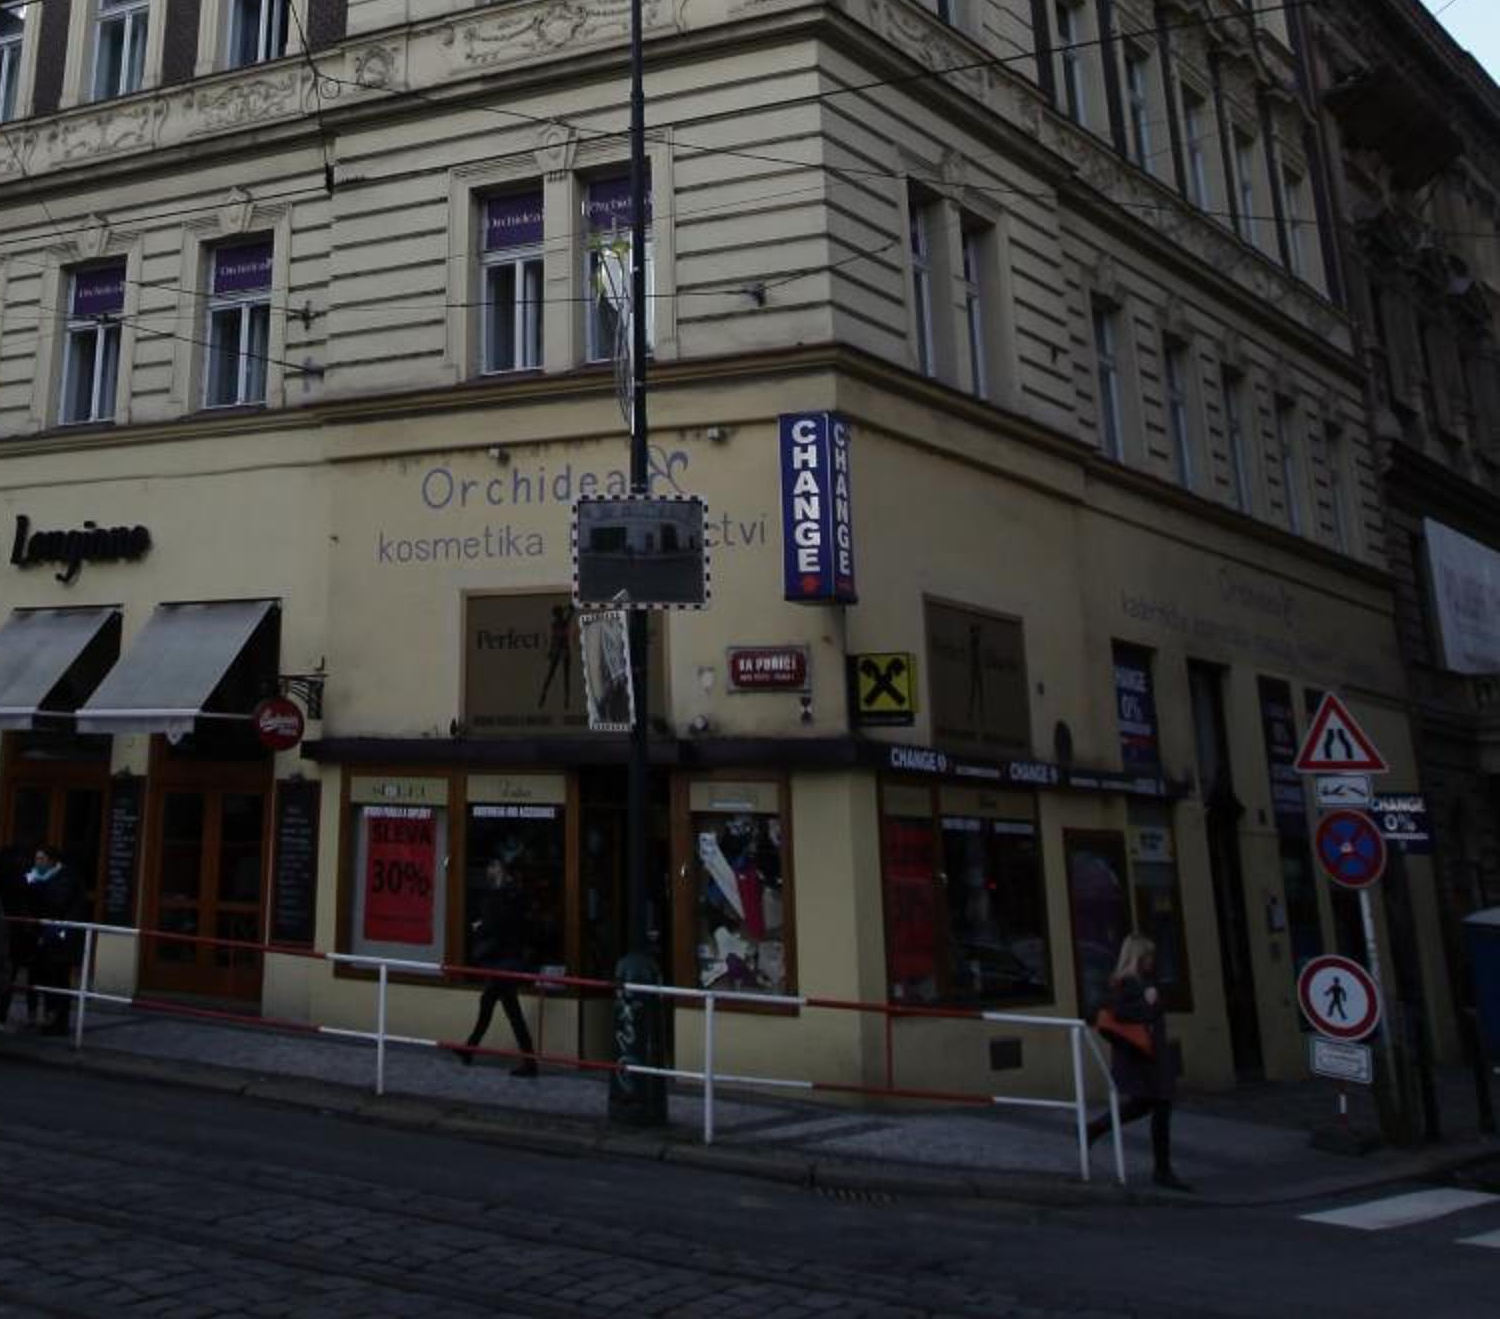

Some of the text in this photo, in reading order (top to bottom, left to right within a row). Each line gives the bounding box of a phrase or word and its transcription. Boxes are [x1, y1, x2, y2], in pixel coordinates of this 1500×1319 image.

[421, 464, 626, 510] Orchidea
[790, 419, 821, 573] CHANGE
[833, 422, 852, 576] CHANGE
[379, 523, 543, 564] kosmetika
[476, 629, 539, 649] Perfect
[1371, 795, 1427, 813] CHANGE
[1383, 813, 1419, 832] 0%
[371, 822, 432, 846] SLEVA
[371, 858, 431, 898] 30%
